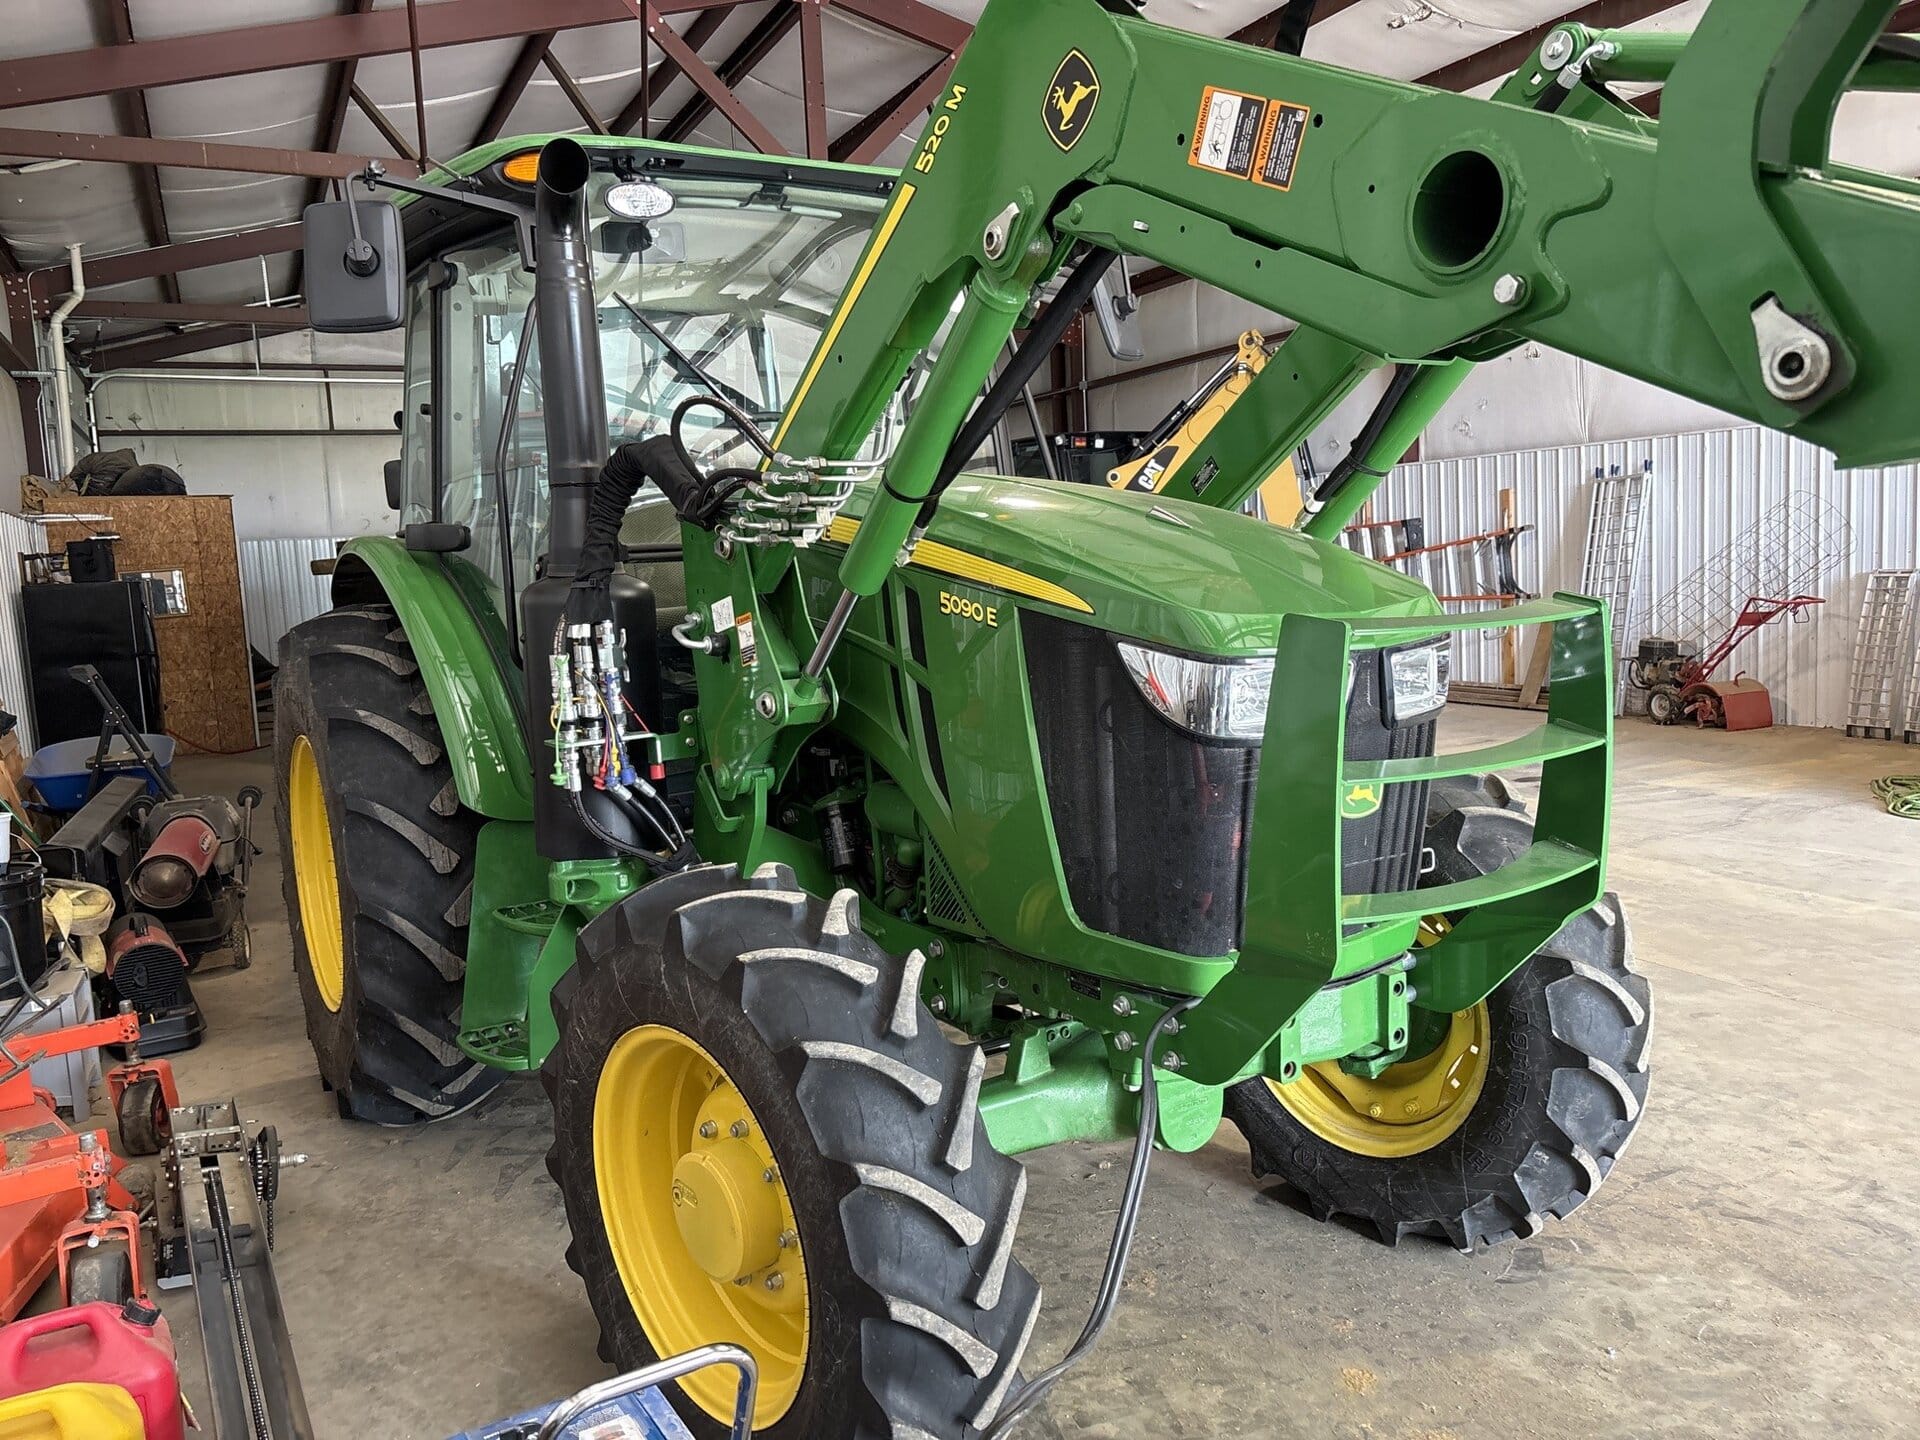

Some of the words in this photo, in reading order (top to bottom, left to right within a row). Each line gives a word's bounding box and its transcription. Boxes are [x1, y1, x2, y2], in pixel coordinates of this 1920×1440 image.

[914, 115, 950, 174] 520
[944, 84, 968, 111] M
[1194, 95, 1211, 145] WARNING
[1259, 109, 1277, 161] WARNING
[1138, 458, 1165, 490] CAT
[940, 590, 984, 622] 5090
[986, 606, 998, 628] E
